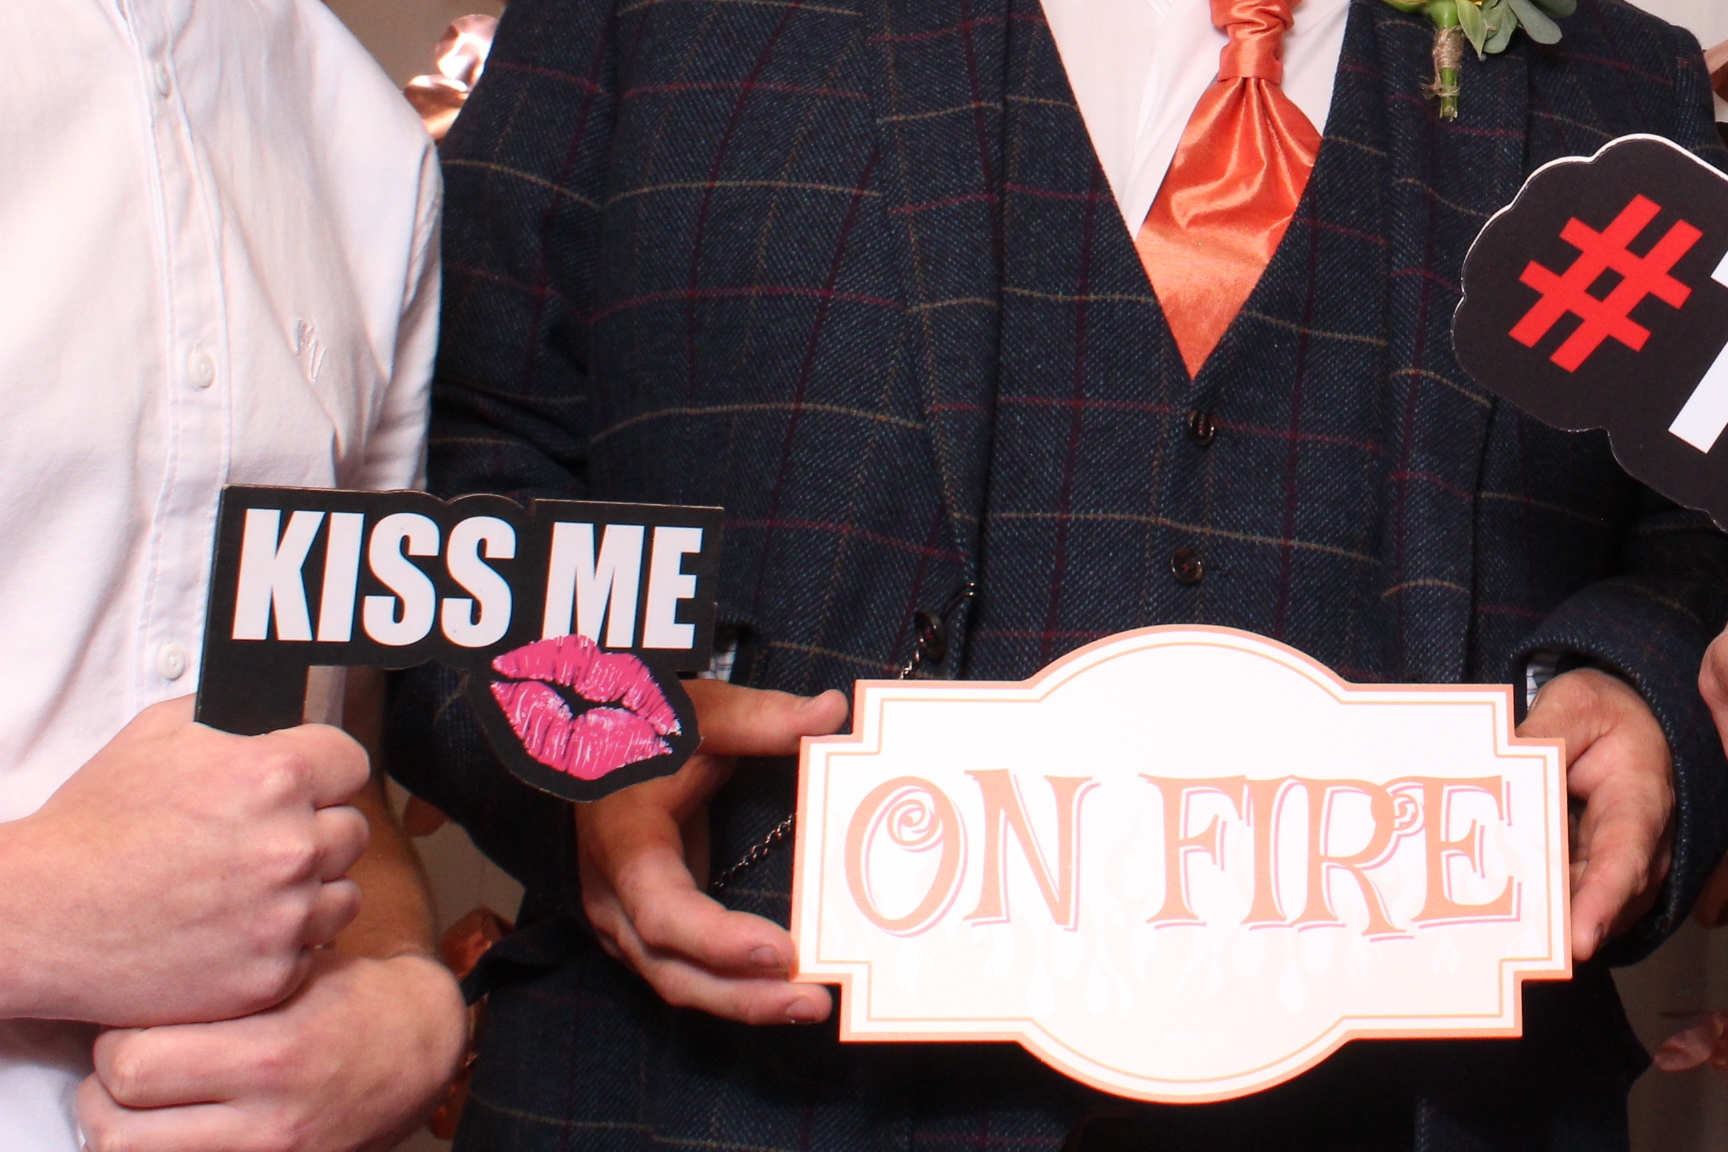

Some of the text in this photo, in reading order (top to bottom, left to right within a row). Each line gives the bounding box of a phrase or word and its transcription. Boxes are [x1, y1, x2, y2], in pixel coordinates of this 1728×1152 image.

[231, 508, 704, 649] KISS ME
[843, 767, 1523, 943] ON FIRE
